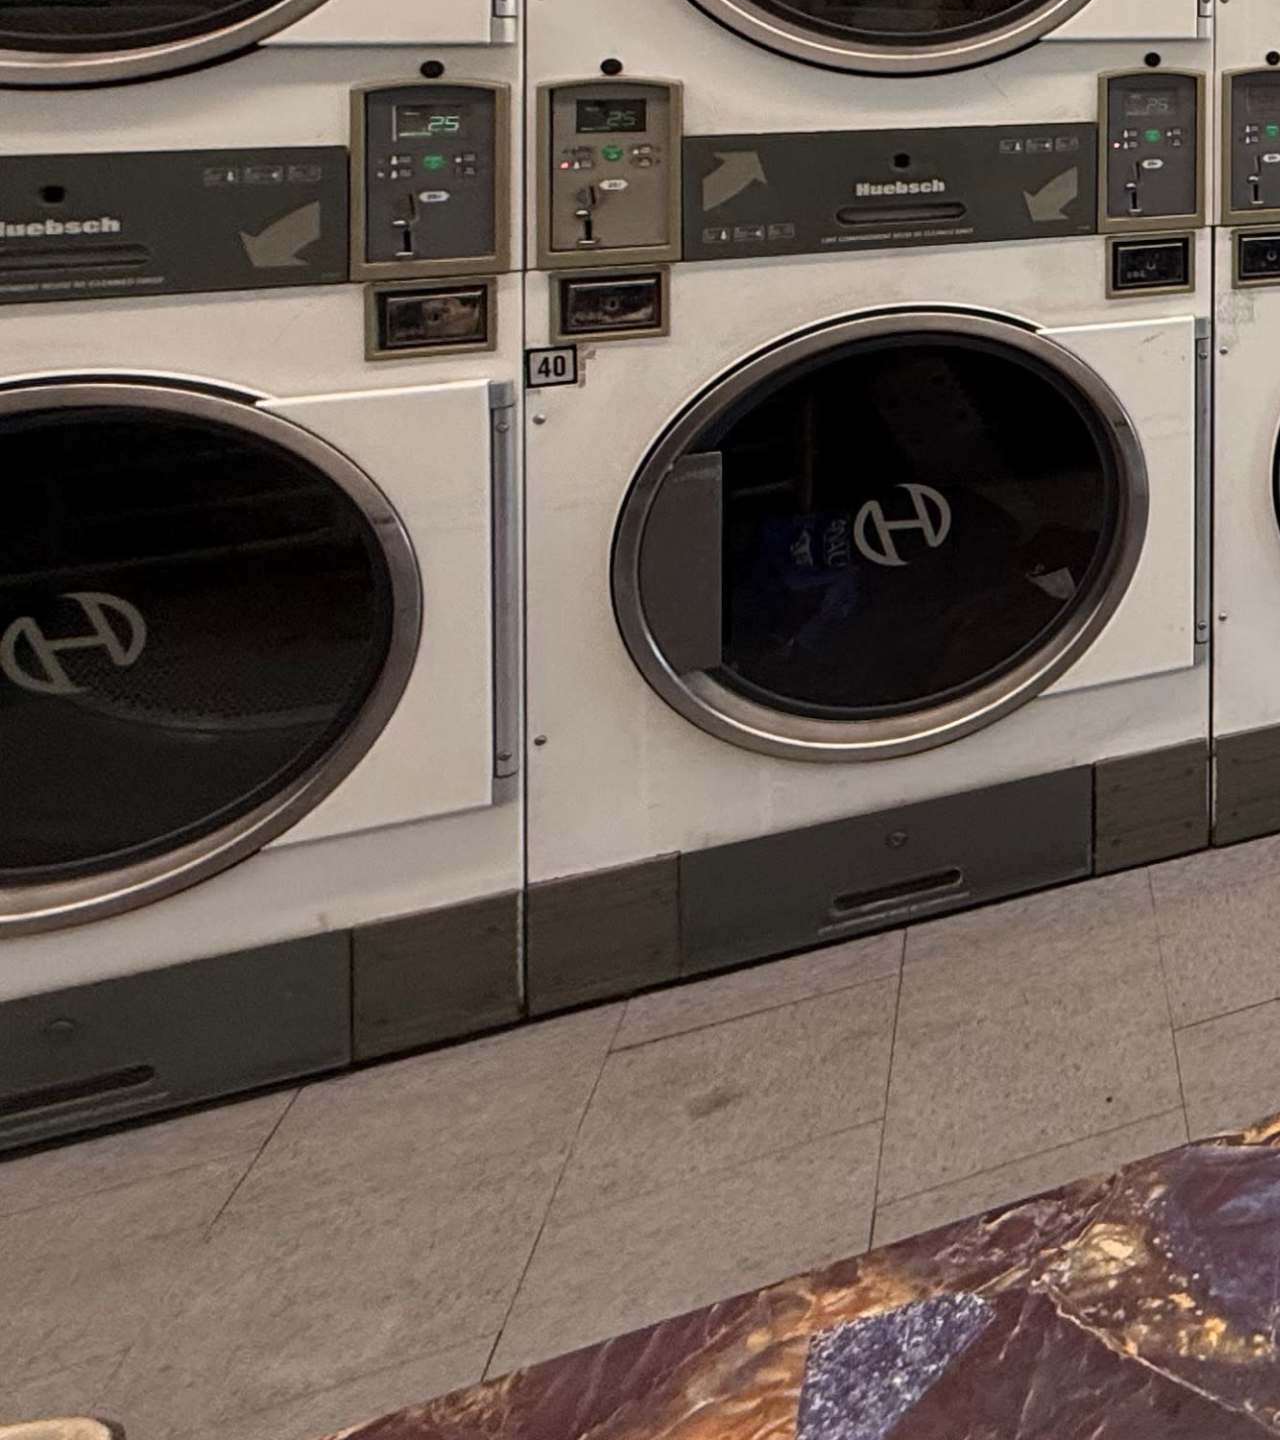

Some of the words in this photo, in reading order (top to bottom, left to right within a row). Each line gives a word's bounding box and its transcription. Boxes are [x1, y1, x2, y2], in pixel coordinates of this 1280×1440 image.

[428, 115, 460, 132] 25
[605, 110, 636, 128] 25
[856, 179, 945, 196] Huebsch
[0, 216, 121, 237] uebsch
[537, 355, 566, 380] 40
